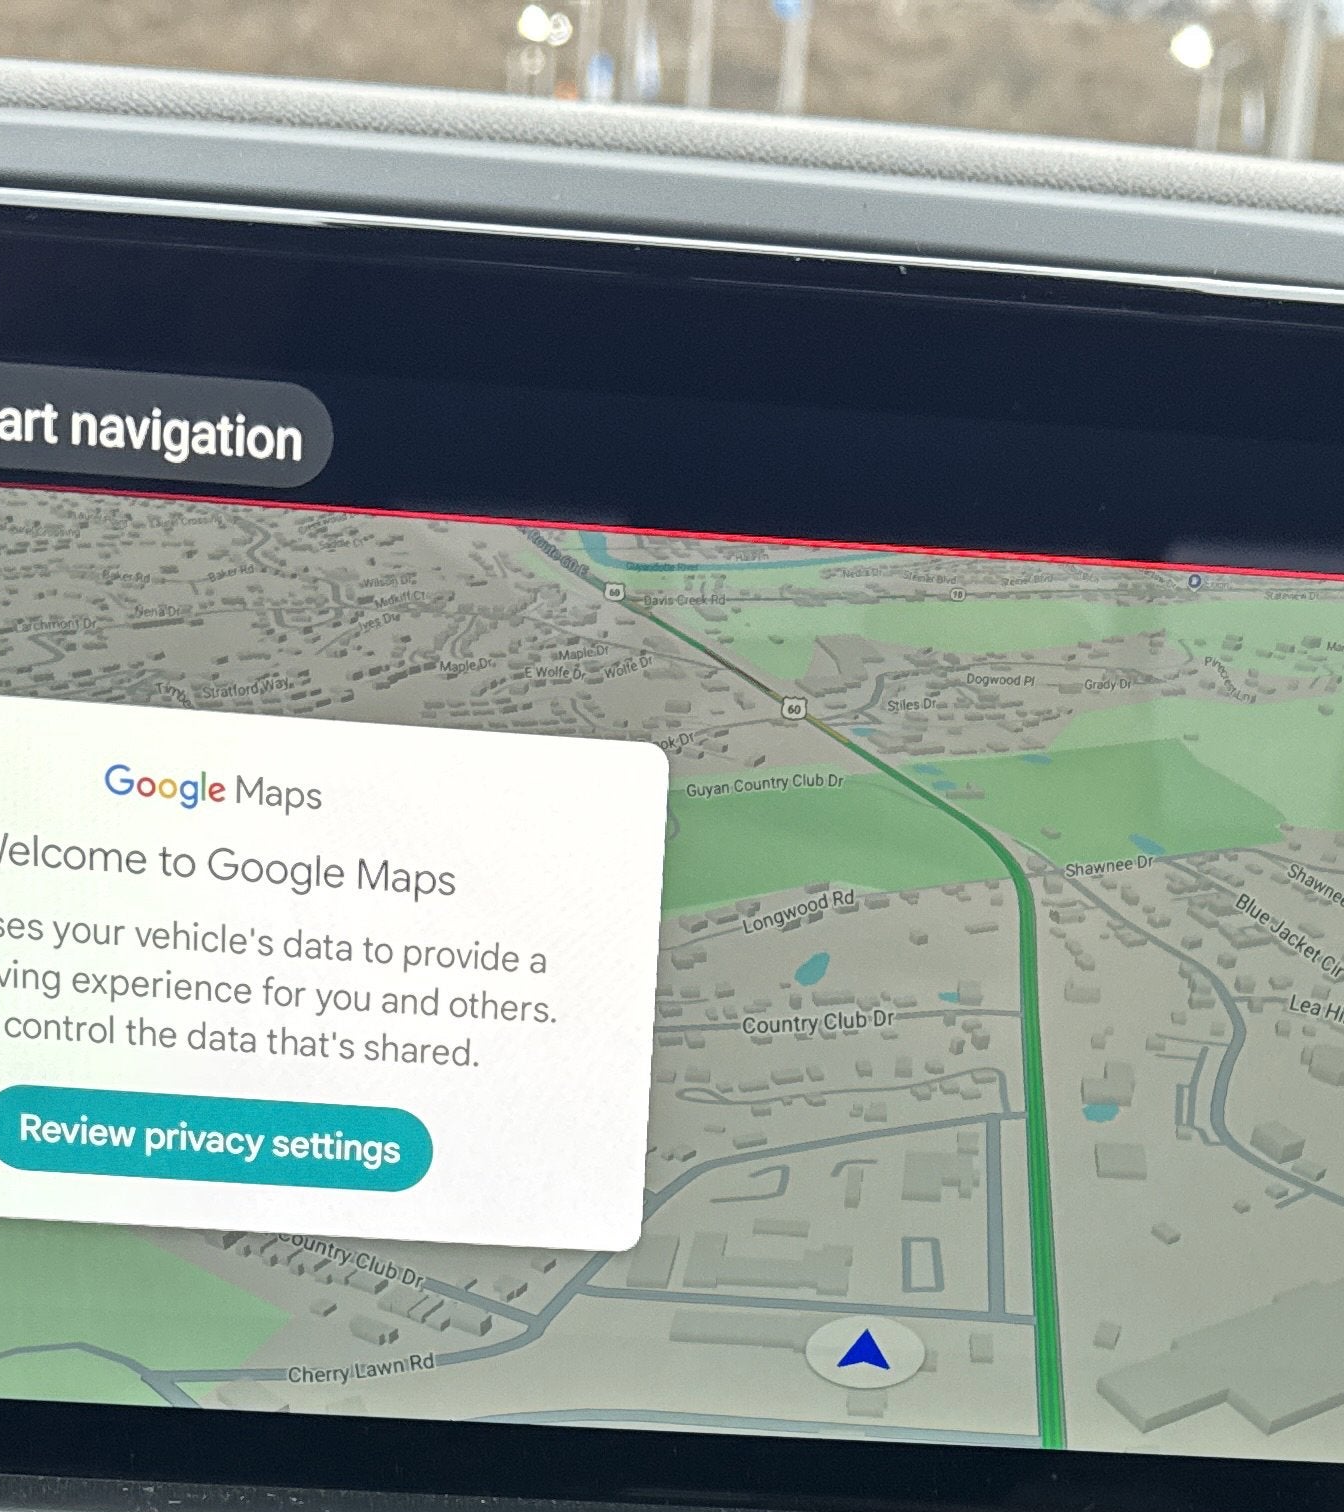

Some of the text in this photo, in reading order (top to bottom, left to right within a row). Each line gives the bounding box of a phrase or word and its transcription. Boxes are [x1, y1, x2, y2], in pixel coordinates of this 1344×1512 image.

[71, 408, 302, 464] navigation
[135, 572, 151, 584] Rd
[208, 564, 255, 583] Baker Rd
[363, 576, 398, 588] Wilson
[609, 588, 620, 597] 60
[644, 594, 725, 606] Davis Creek Rd
[163, 604, 180, 617] Dr
[16, 617, 97, 632] Larchmont Dr
[558, 646, 609, 662] Maple Dr
[439, 658, 493, 681] Maple Dr
[536, 666, 571, 680] Wolfe
[572, 667, 586, 681] Dr
[604, 656, 653, 679] Wolfe Dr
[203, 677, 290, 699] Stratford Way
[967, 672, 1021, 687] Dogwood
[1084, 679, 1131, 692] Grady Dr
[787, 703, 802, 716] 60
[888, 698, 936, 712] Stiles Dr
[678, 732, 695, 746] Dr
[104, 764, 323, 816] Google Maps
[686, 772, 844, 799] Guyan Country Club Dr
[158, 846, 196, 878] to
[207, 847, 345, 895] Google
[357, 858, 456, 903] Maps
[1065, 855, 1154, 879] Shawnee Dr
[742, 889, 854, 935] Longwood Rd
[52, 920, 126, 949] your
[135, 921, 274, 957] vehicle's
[283, 929, 353, 962] data
[362, 937, 394, 964] to
[403, 940, 520, 974] provide
[529, 952, 547, 974] a
[1235, 893, 1344, 979] Blue Jacket Cir
[72, 970, 252, 1004] experience
[262, 976, 306, 1007] for
[316, 987, 371, 1017] you
[381, 987, 440, 1017] and
[449, 990, 558, 1024] others.
[1289, 994, 1321, 1016] Lea
[742, 1010, 895, 1038] Country Club Dr
[4, 1015, 115, 1045] control
[125, 1017, 177, 1049] the
[187, 1021, 257, 1053] data
[267, 1026, 355, 1060] that's
[364, 1032, 480, 1067] shared.
[19, 1113, 401, 1170] Review privacy settings
[356, 1252, 397, 1280] Club
[402, 1268, 424, 1289] Dr
[288, 1352, 435, 1385] Cherry Lawn Rd
